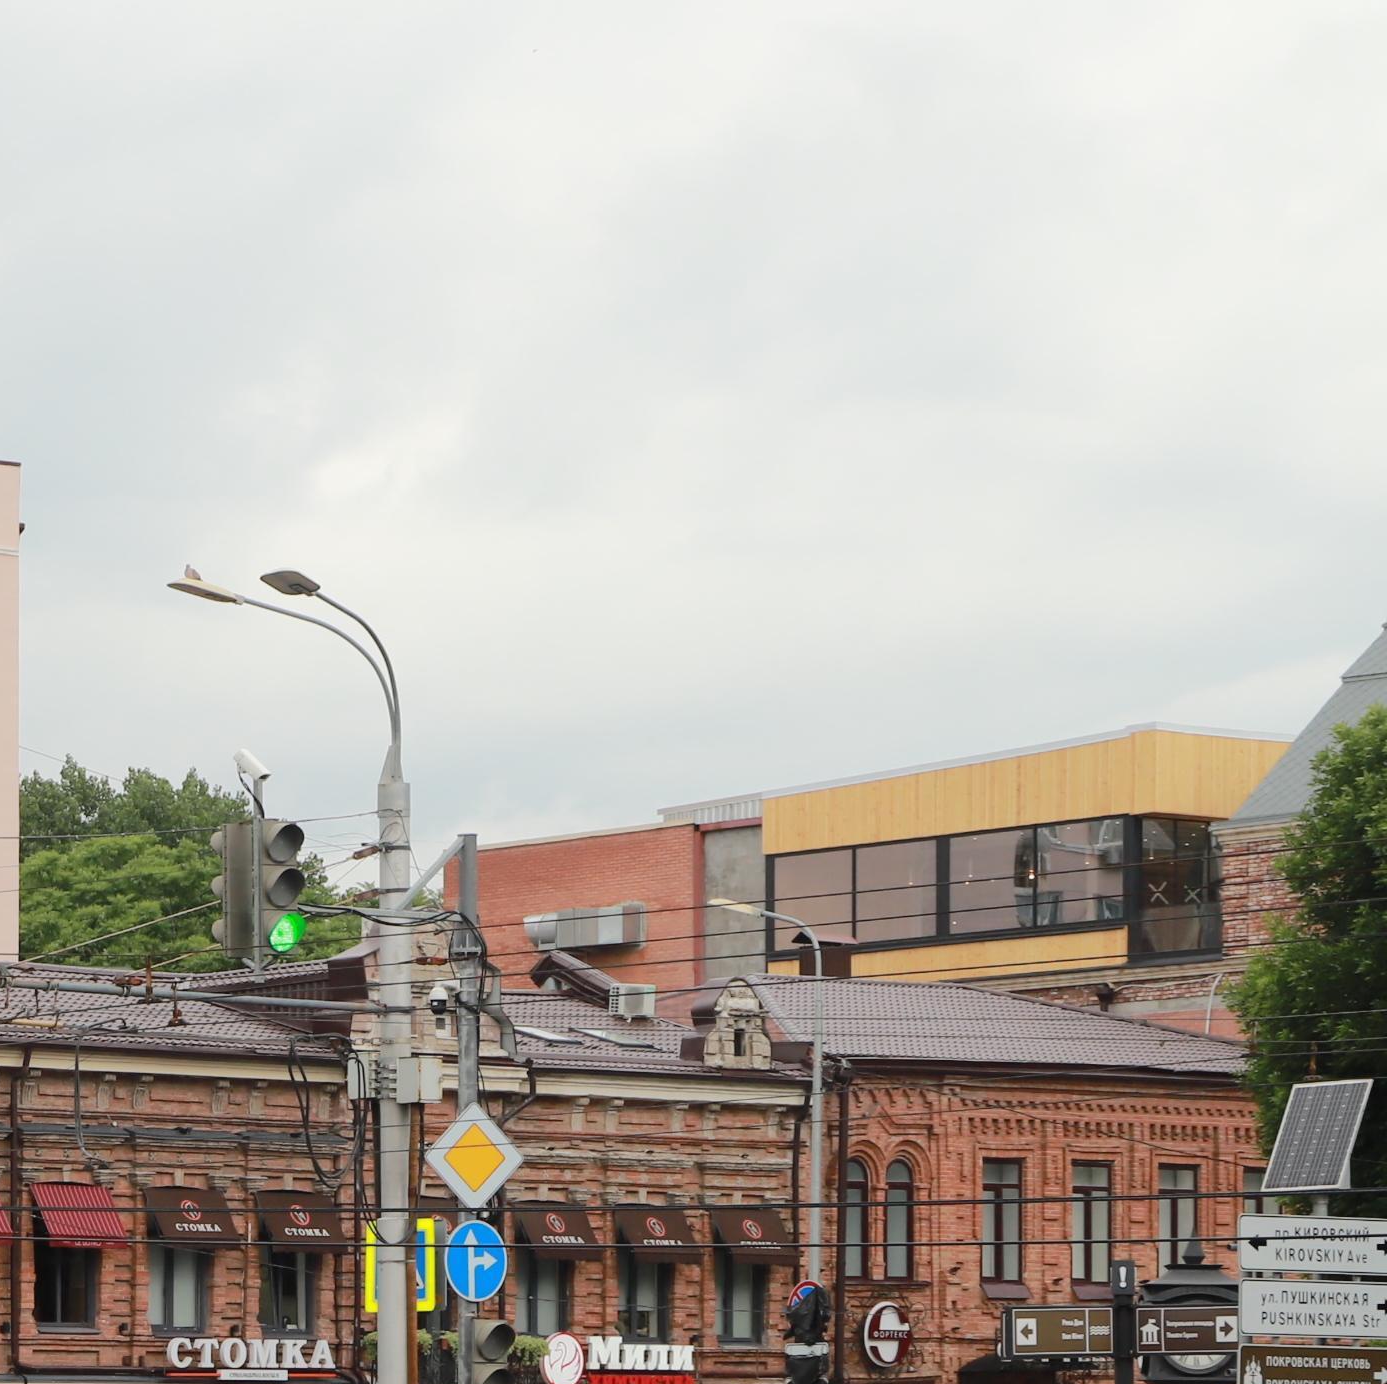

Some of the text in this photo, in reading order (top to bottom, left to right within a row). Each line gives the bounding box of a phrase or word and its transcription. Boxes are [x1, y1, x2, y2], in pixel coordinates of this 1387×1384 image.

[176, 1223, 222, 1233] СТОМКА
[285, 1227, 331, 1238] СТОМКА
[1275, 1248, 1369, 1264] KIROVSKIY Ave
[1281, 1290, 1369, 1307] ПУШКИНСКАЯ
[1261, 1311, 1381, 1328] PUSHKINSKAYA Str
[167, 1338, 337, 1370] СТОМКА
[587, 1335, 696, 1372] Мили
[1265, 1356, 1371, 1370] ПОКРОВСКАЯ ЦЕРКОВЬ
